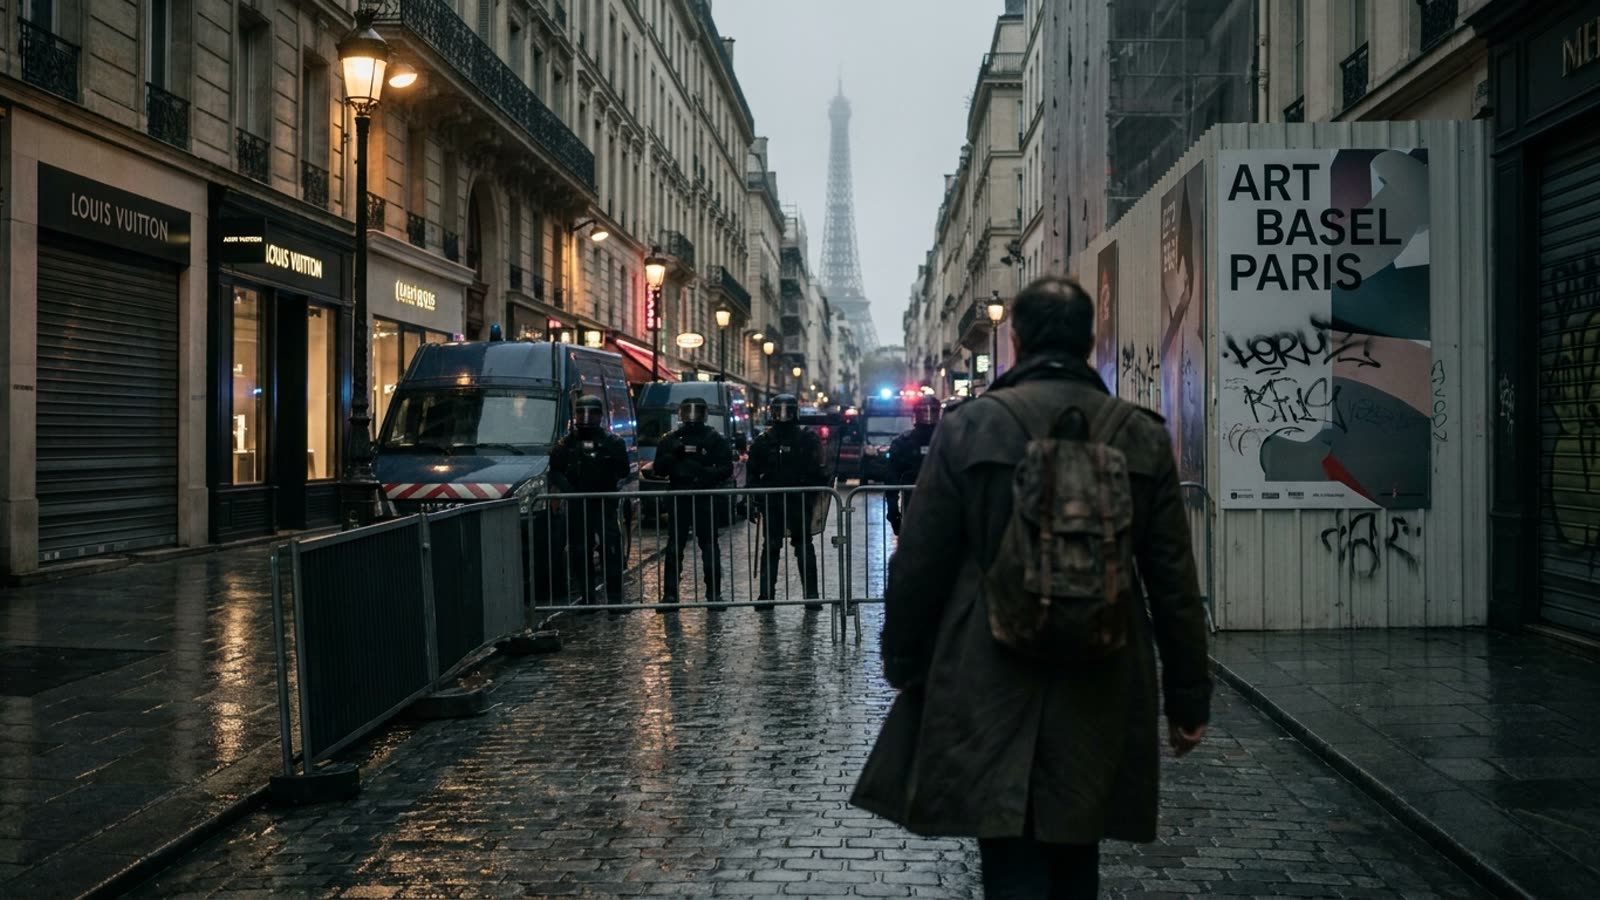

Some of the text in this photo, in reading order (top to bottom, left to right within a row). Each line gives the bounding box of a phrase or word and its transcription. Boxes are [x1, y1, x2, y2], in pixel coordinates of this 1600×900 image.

[1561, 16, 1600, 77] ME
[1228, 163, 1320, 201] ART
[71, 192, 168, 242] LOUIS VUITTON
[1256, 208, 1402, 246] BASEL
[290, 250, 322, 279] VUITTON
[1230, 252, 1362, 292] PARIS
